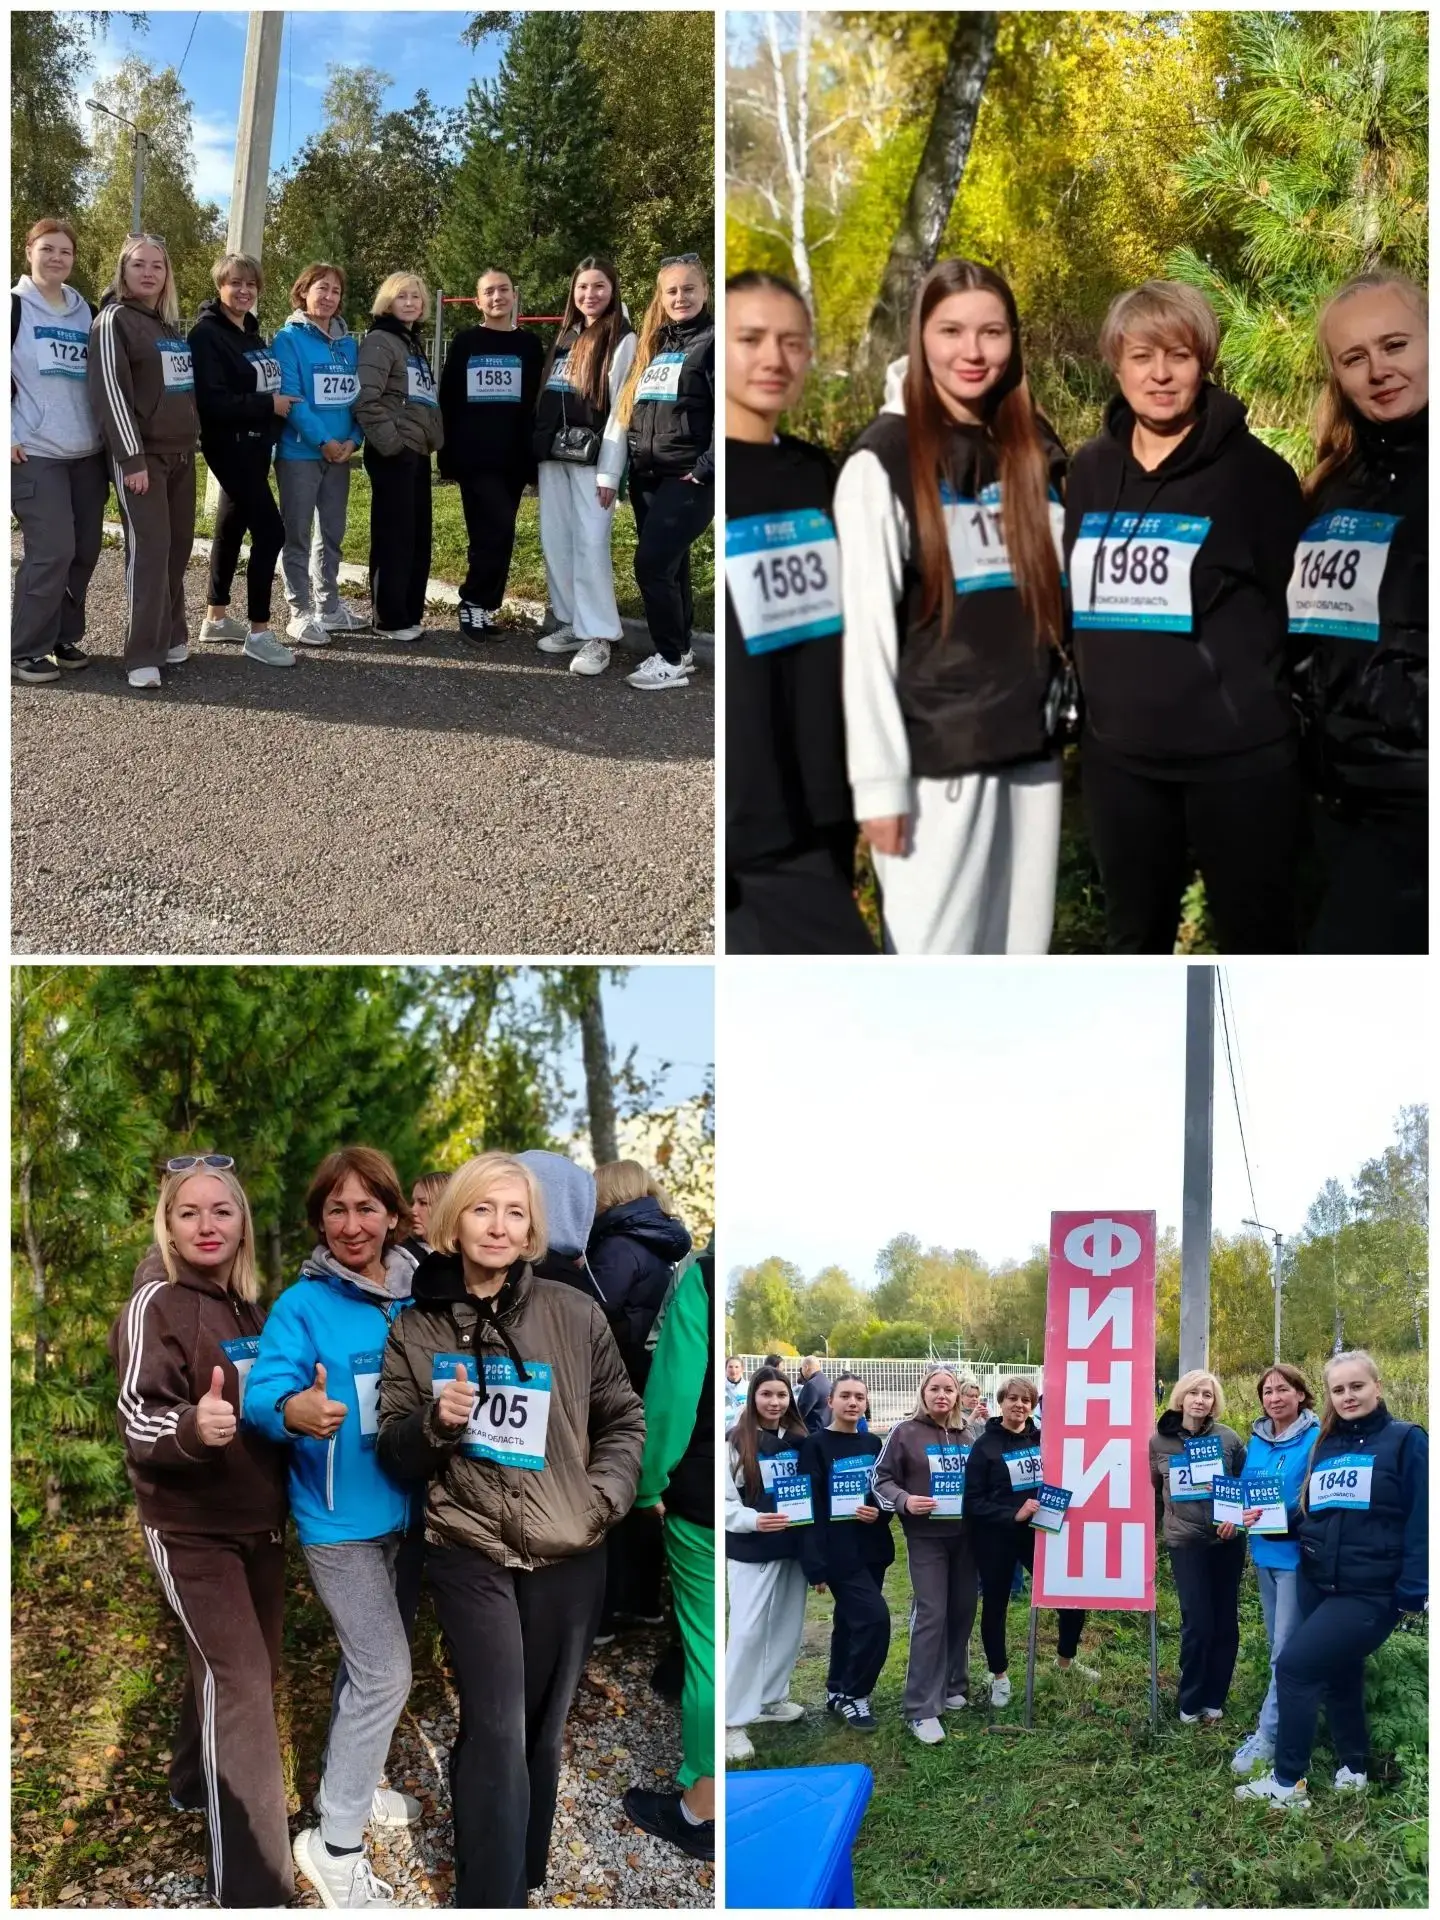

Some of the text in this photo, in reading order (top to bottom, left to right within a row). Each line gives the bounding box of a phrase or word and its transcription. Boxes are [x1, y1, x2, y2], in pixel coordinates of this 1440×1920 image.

[50, 341, 88, 361] 1724
[323, 377, 356, 394] 2742
[476, 370, 512, 386] 1583
[971, 511, 1004, 547] 17
[1098, 545, 1170, 585] 1988
[1300, 548, 1361, 590] 1848
[752, 550, 828, 603] 1583
[1097, 596, 1129, 605] ОМСКАЯ
[472, 1390, 528, 1429] 705
[1043, 1218, 1145, 1599] ФИНИШ
[464, 1427, 525, 1446] СКАЯ ОБЛАСТЬ
[1190, 1445, 1218, 1456] КРОСС
[833, 1480, 861, 1489] КРОСС
[934, 1481, 960, 1489] КРОСС
[1319, 1469, 1358, 1491] 1848
[777, 1485, 807, 1495] КРОСС
[1041, 1492, 1066, 1505] КРОСС
[1215, 1485, 1240, 1496] КРОСС
[1249, 1487, 1279, 1498] КРОСС
